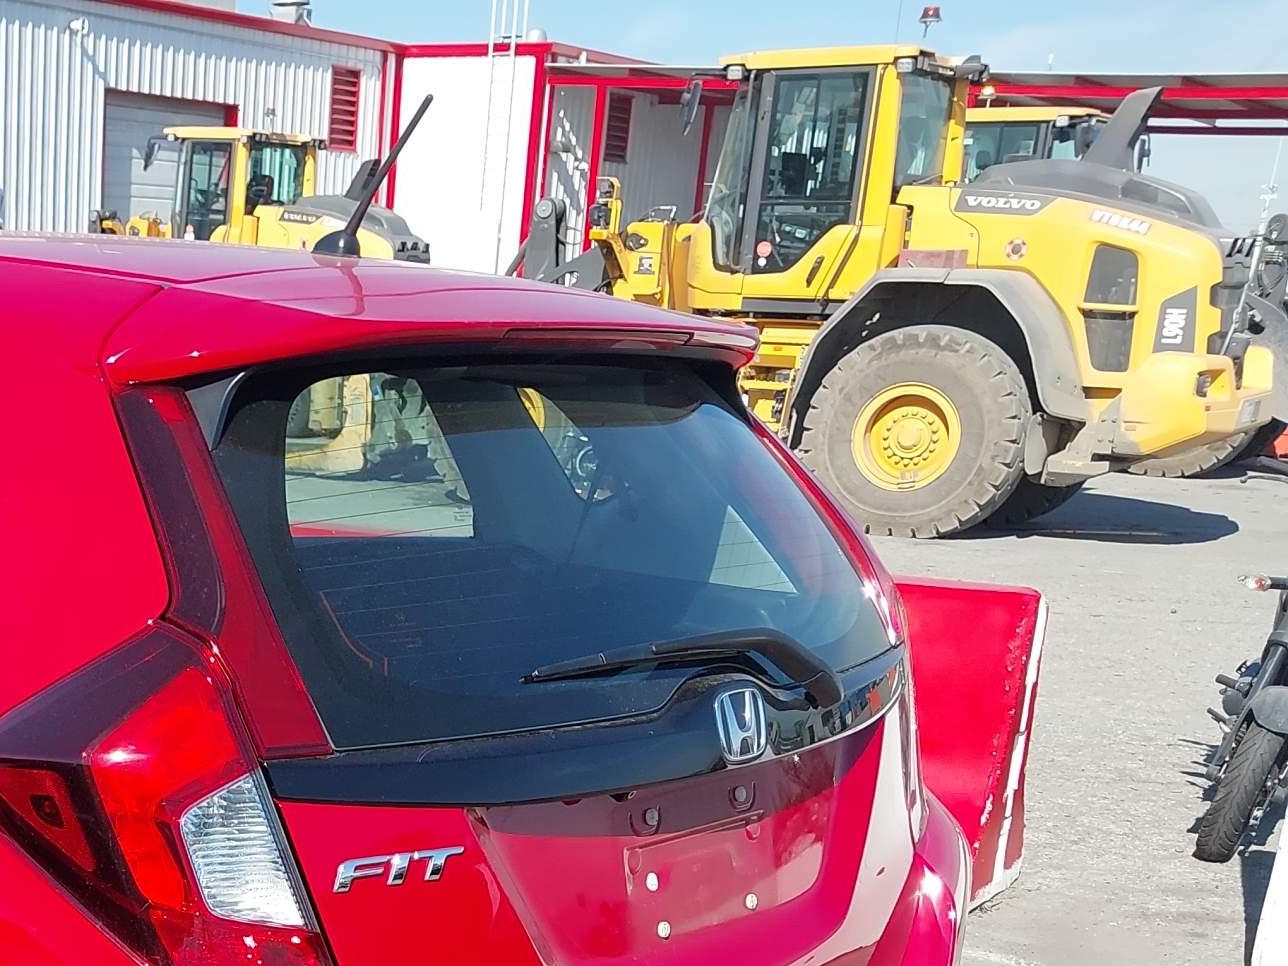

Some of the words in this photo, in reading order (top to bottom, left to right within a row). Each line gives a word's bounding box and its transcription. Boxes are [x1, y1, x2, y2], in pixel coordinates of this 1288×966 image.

[965, 195, 1041, 210] VOLVO
[1161, 308, 1188, 345] L90H
[333, 845, 465, 894] FIT
